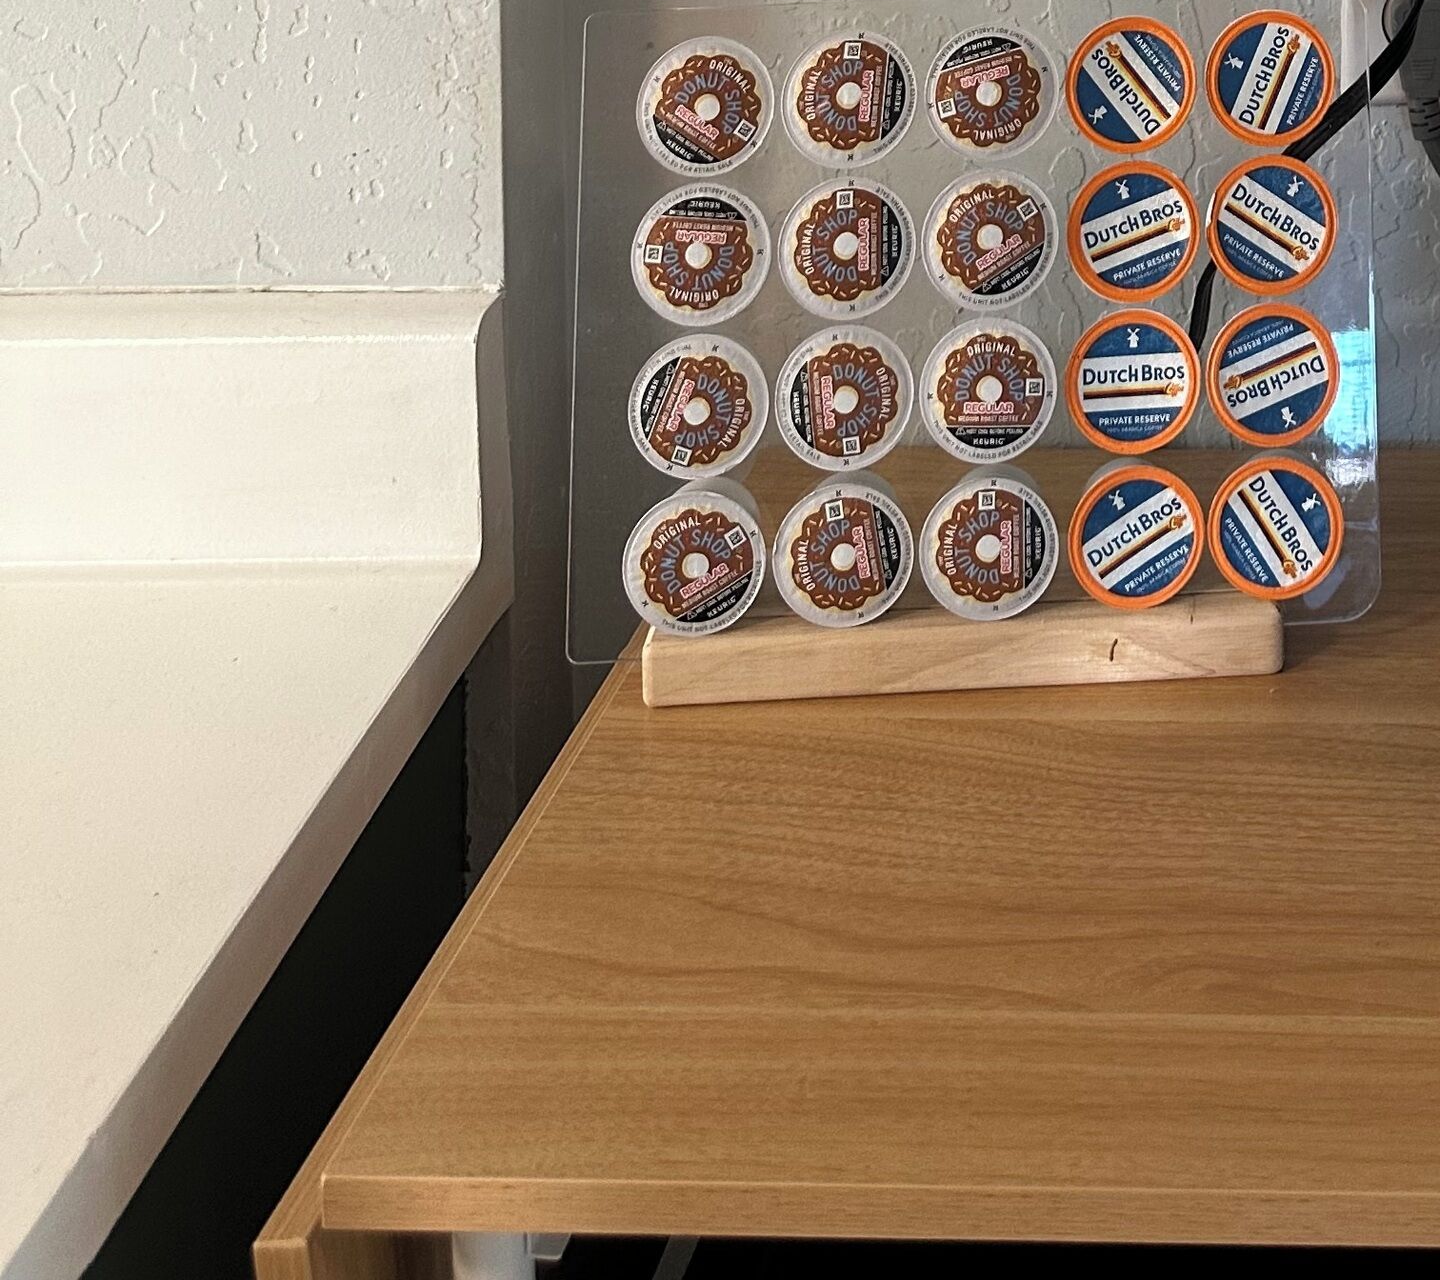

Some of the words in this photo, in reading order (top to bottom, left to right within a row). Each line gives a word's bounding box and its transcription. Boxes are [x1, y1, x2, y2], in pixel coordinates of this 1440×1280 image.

[1132, 32, 1159, 65] RESERVE
[709, 61, 750, 92] ORIGINAL
[821, 60, 863, 87] SHOP
[959, 64, 1010, 88] REGULAR
[1155, 61, 1181, 92] PRIVATE
[1285, 91, 1304, 125] PRIVATE
[1298, 56, 1319, 91] RESERVE
[674, 72, 730, 104] DONUT
[722, 88, 742, 135] SHOP
[804, 70, 820, 120] ORIGINAL
[815, 92, 856, 131] DONUT
[858, 70, 875, 122] REGULAR
[953, 90, 986, 126] SHOP
[992, 73, 1023, 126] DONUT
[674, 103, 720, 140] REGULAR
[973, 118, 1021, 139] ORIGINAL
[816, 208, 857, 239] SHOP
[949, 189, 994, 223] ORIGINAL
[675, 229, 727, 244] REGULAR
[801, 223, 814, 274] ORIGINAL
[857, 217, 869, 271] REGULAR
[955, 207, 981, 266] DONUT
[984, 201, 1024, 231] SHOP
[974, 233, 1023, 271] REGULAR
[663, 241, 688, 285] SHOP
[691, 246, 734, 290] DONUT
[812, 245, 856, 282] DONUT
[1112, 262, 1146, 281] PRIVATE
[1145, 247, 1181, 267] RESERVE
[1223, 233, 1253, 258] PRIVATE
[1252, 252, 1285, 278] RESERVE
[669, 287, 718, 302] ORIGINAL
[966, 341, 1015, 355] ORIGINAL
[1225, 337, 1261, 358] RESERVE
[1261, 322, 1294, 343] PRIVATE
[832, 362, 879, 397] DONUT
[876, 367, 891, 418] ORIGINAL
[955, 354, 994, 400] DONUT
[998, 358, 1024, 400] SHOP
[665, 378, 696, 431] REGULAR
[695, 373, 732, 424] DONUT
[821, 374, 835, 429] REGULAR
[963, 402, 1013, 413] REGULAR
[673, 424, 719, 447] SHOP
[718, 398, 744, 448] ORIGINAL
[837, 404, 876, 437] SHOP
[1099, 416, 1132, 425] PRIVATE
[1134, 413, 1170, 423] RESERVE
[653, 516, 700, 549] ORIGINAL
[811, 518, 850, 553] SHOP
[958, 510, 999, 540] SHOP
[659, 534, 686, 593] DONUT
[690, 529, 732, 559] SHOP
[851, 524, 870, 579] REGULAR
[943, 524, 956, 575] ORIGINAL
[954, 546, 999, 583] DONUT
[1000, 519, 1011, 573] REGULAR
[1224, 516, 1248, 550] PRIVATE
[1243, 547, 1269, 583] RESERVE
[678, 561, 730, 599] REGULAR
[797, 540, 815, 590] ORIGINAL
[809, 559, 859, 593] DONUT
[1123, 565, 1156, 591] PRIVATE
[1154, 542, 1189, 570] RESERVE
